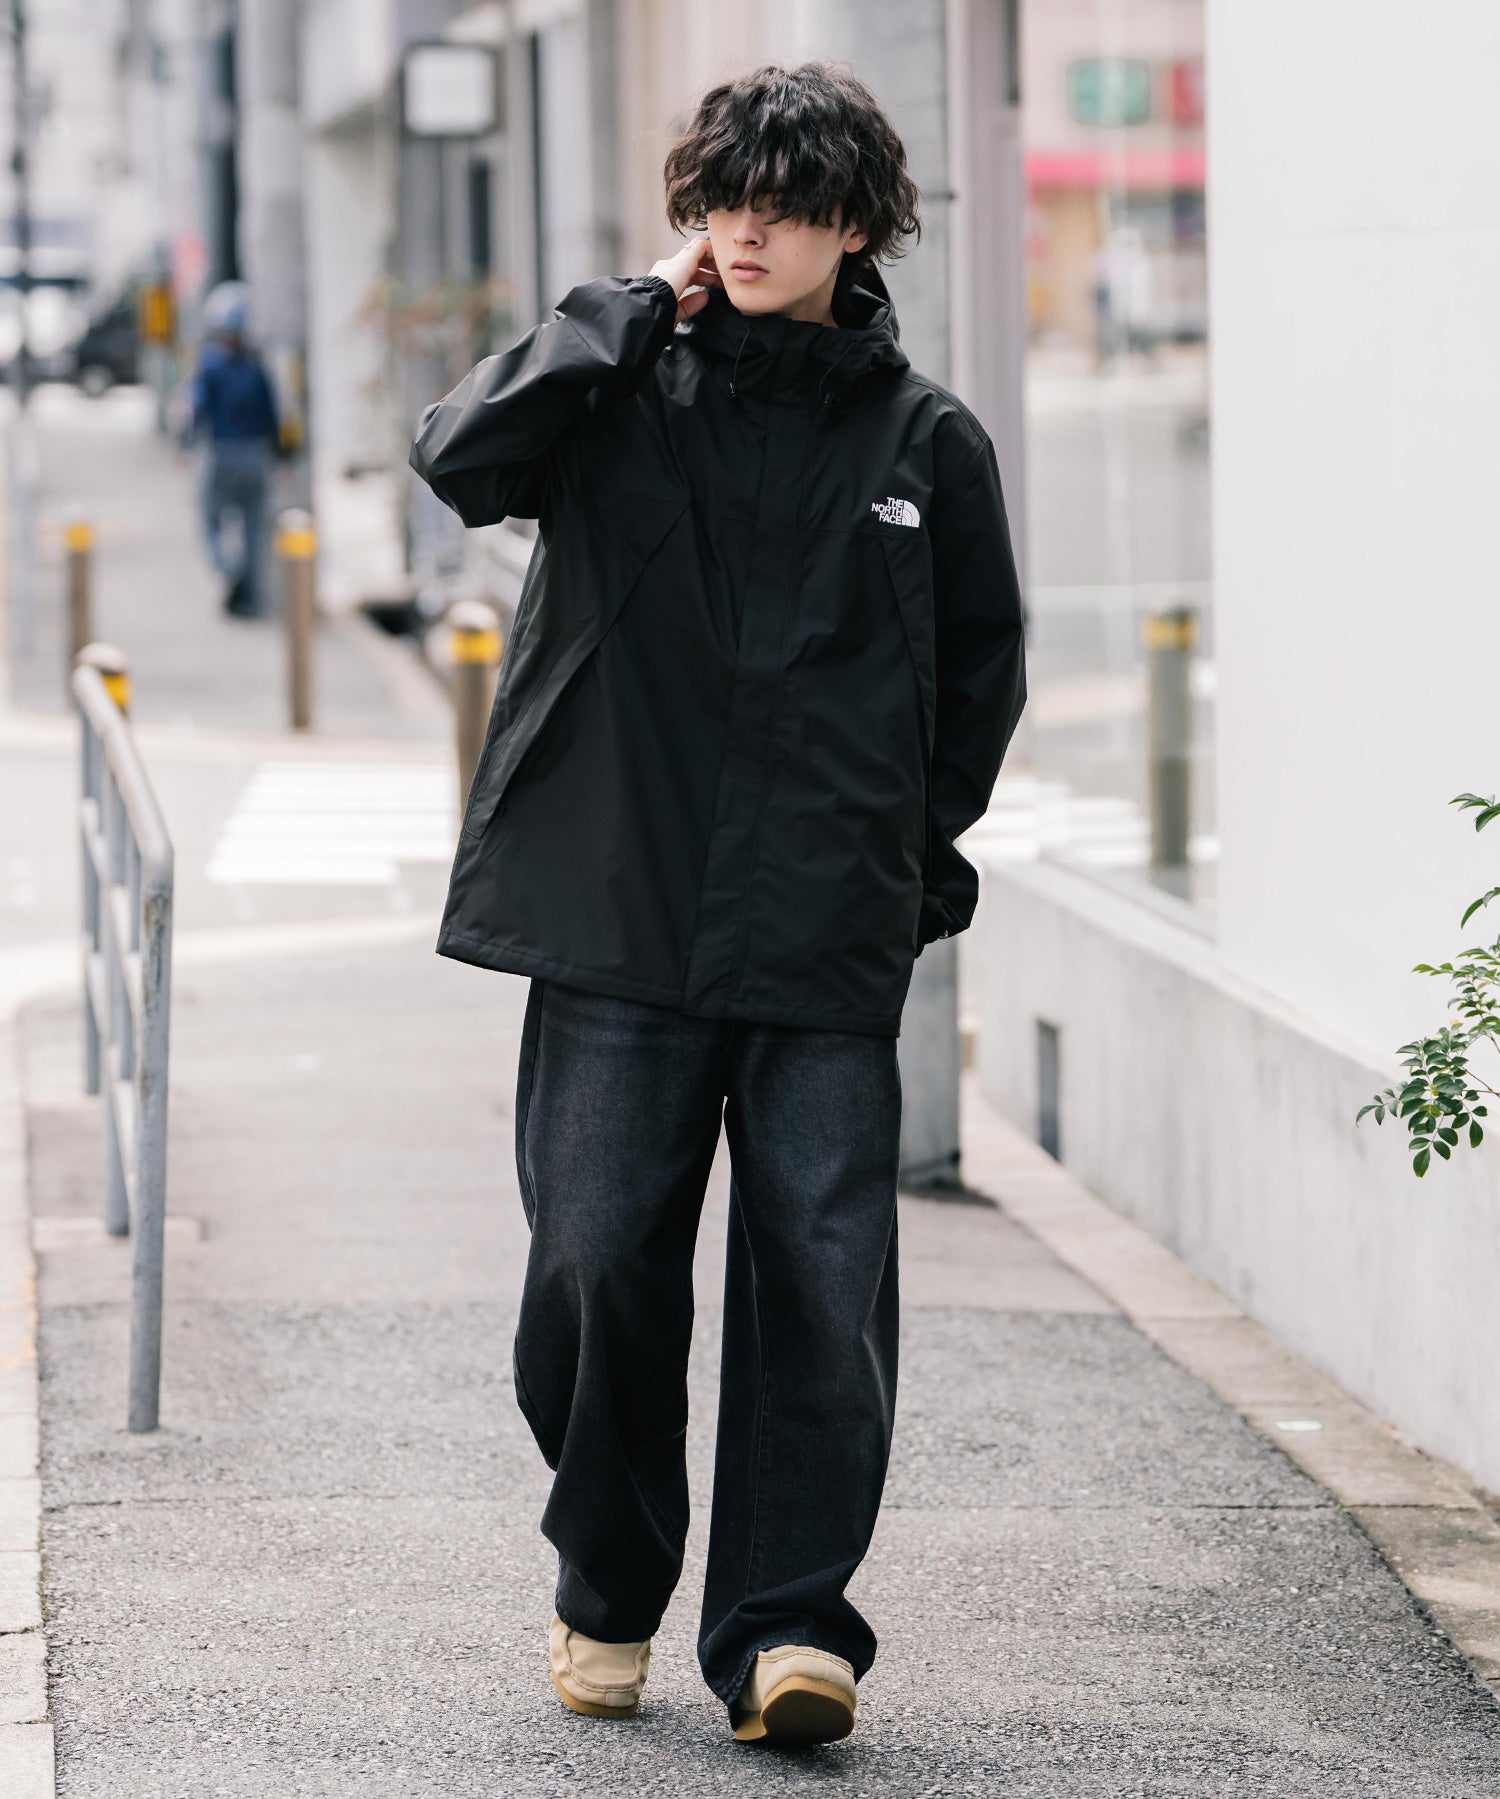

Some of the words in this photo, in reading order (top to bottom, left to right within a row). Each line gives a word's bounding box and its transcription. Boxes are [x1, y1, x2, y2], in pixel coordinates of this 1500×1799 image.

[871, 502, 903, 516] NORTH
[887, 497, 904, 508] THE
[879, 512, 902, 525] FACE
